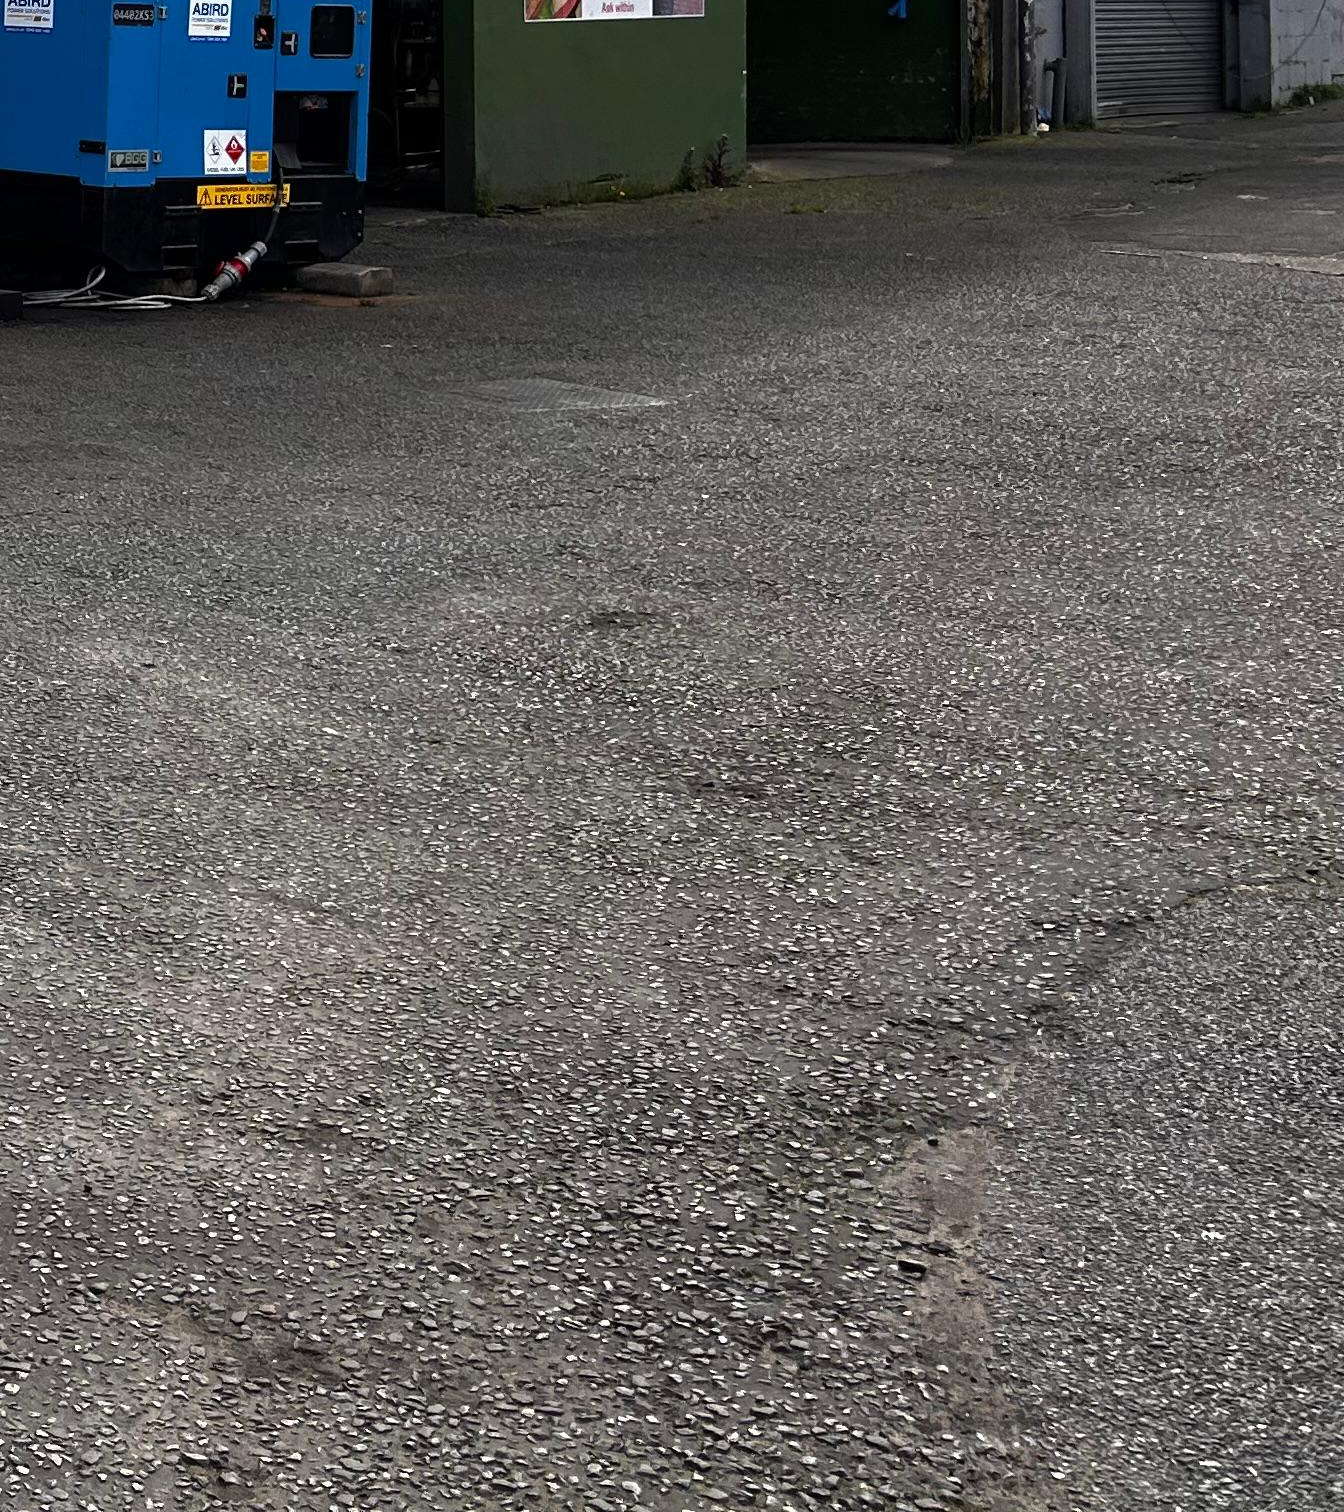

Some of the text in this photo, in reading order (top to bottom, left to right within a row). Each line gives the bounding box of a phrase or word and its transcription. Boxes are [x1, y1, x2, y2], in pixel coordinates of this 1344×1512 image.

[192, 2, 229, 17] ABIRD
[601, 2, 614, 13] Ask
[215, 193, 287, 205] LEVEL SURFAE
